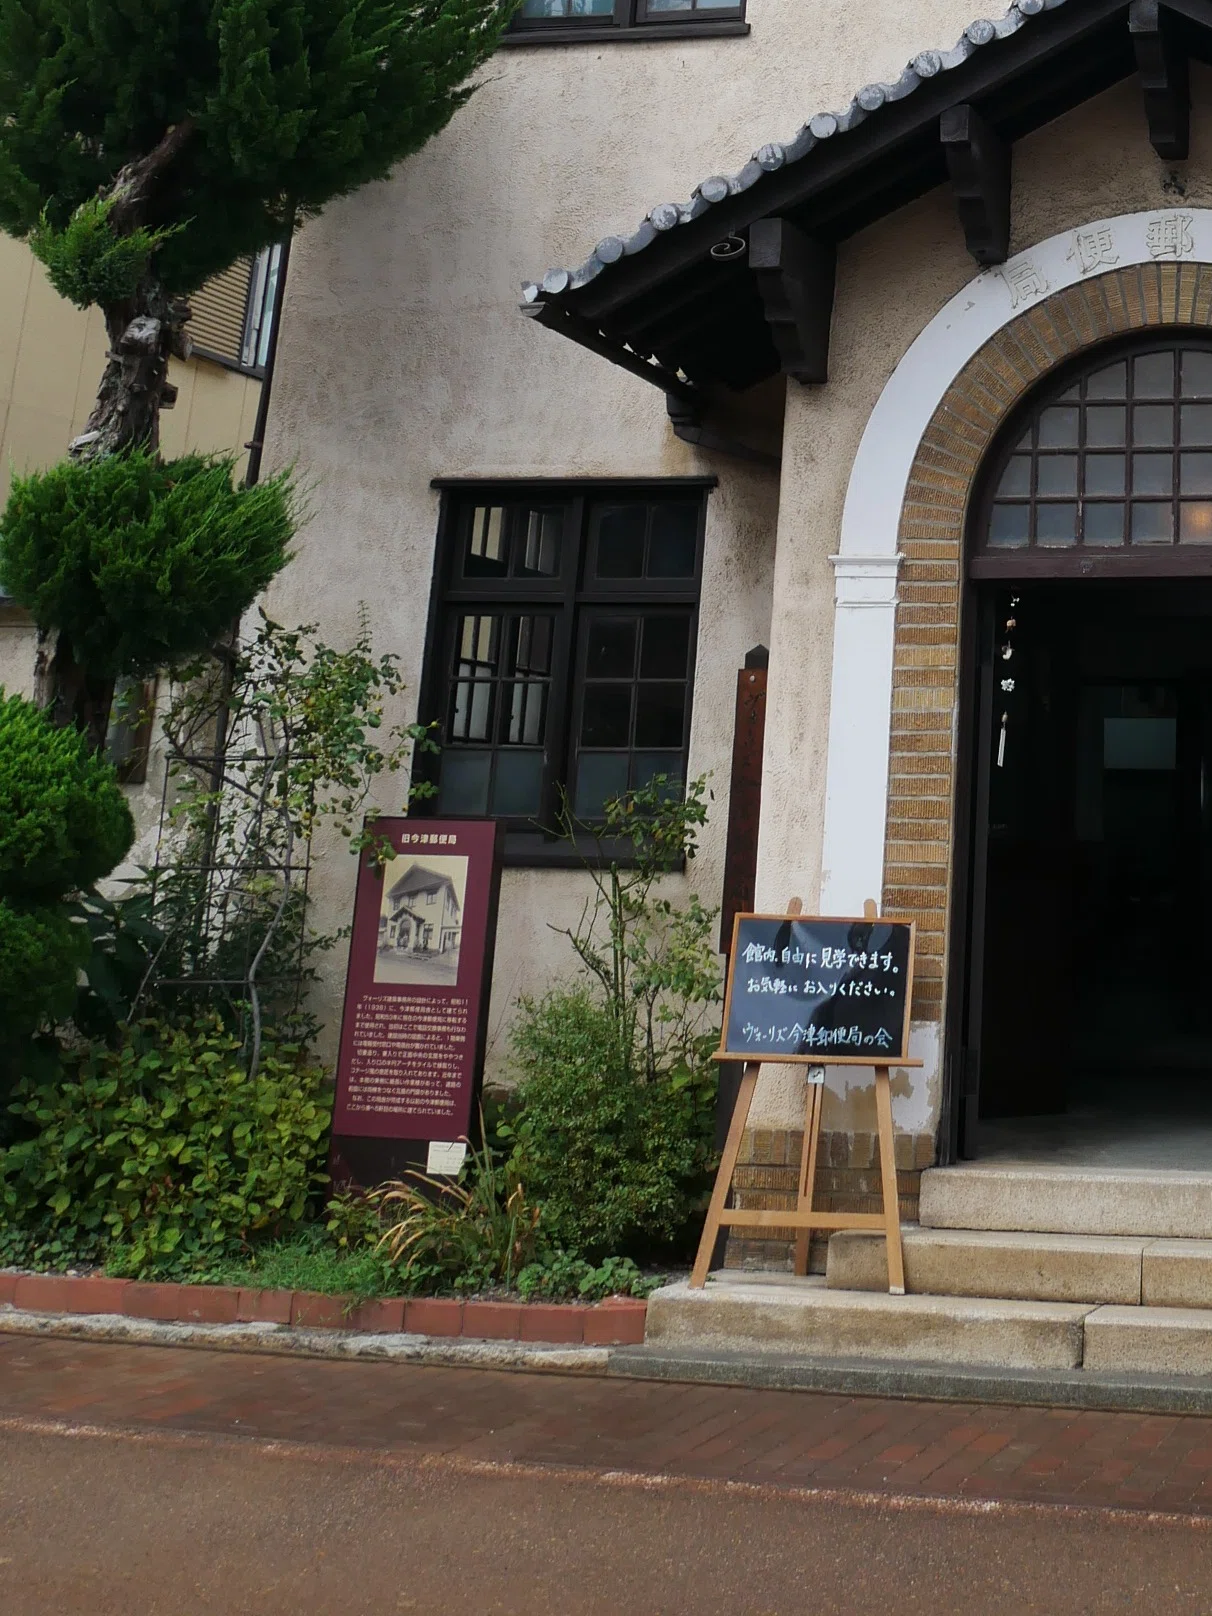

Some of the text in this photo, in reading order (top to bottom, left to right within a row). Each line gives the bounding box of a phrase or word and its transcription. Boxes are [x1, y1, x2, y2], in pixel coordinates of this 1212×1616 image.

[401, 833, 457, 845] 旧今津郵便局
